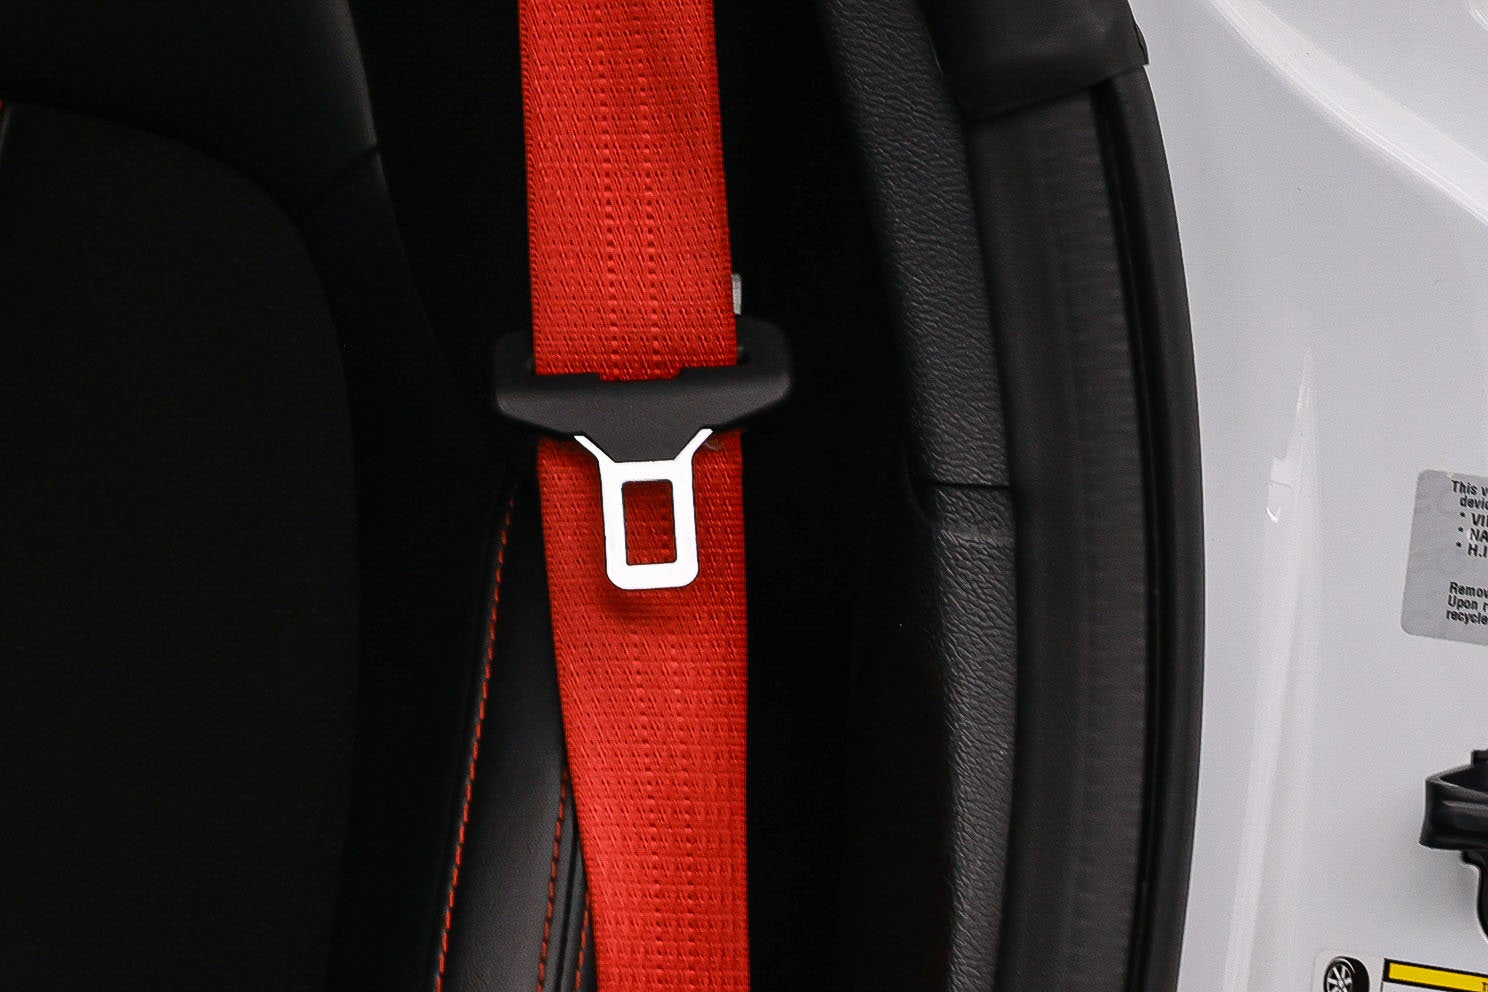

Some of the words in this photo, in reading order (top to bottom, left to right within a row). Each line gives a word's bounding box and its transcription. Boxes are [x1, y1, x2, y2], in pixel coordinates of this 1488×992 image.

[1451, 480, 1478, 495] This
[1448, 594, 1478, 610] Upon
[1446, 610, 1488, 626] recycle
